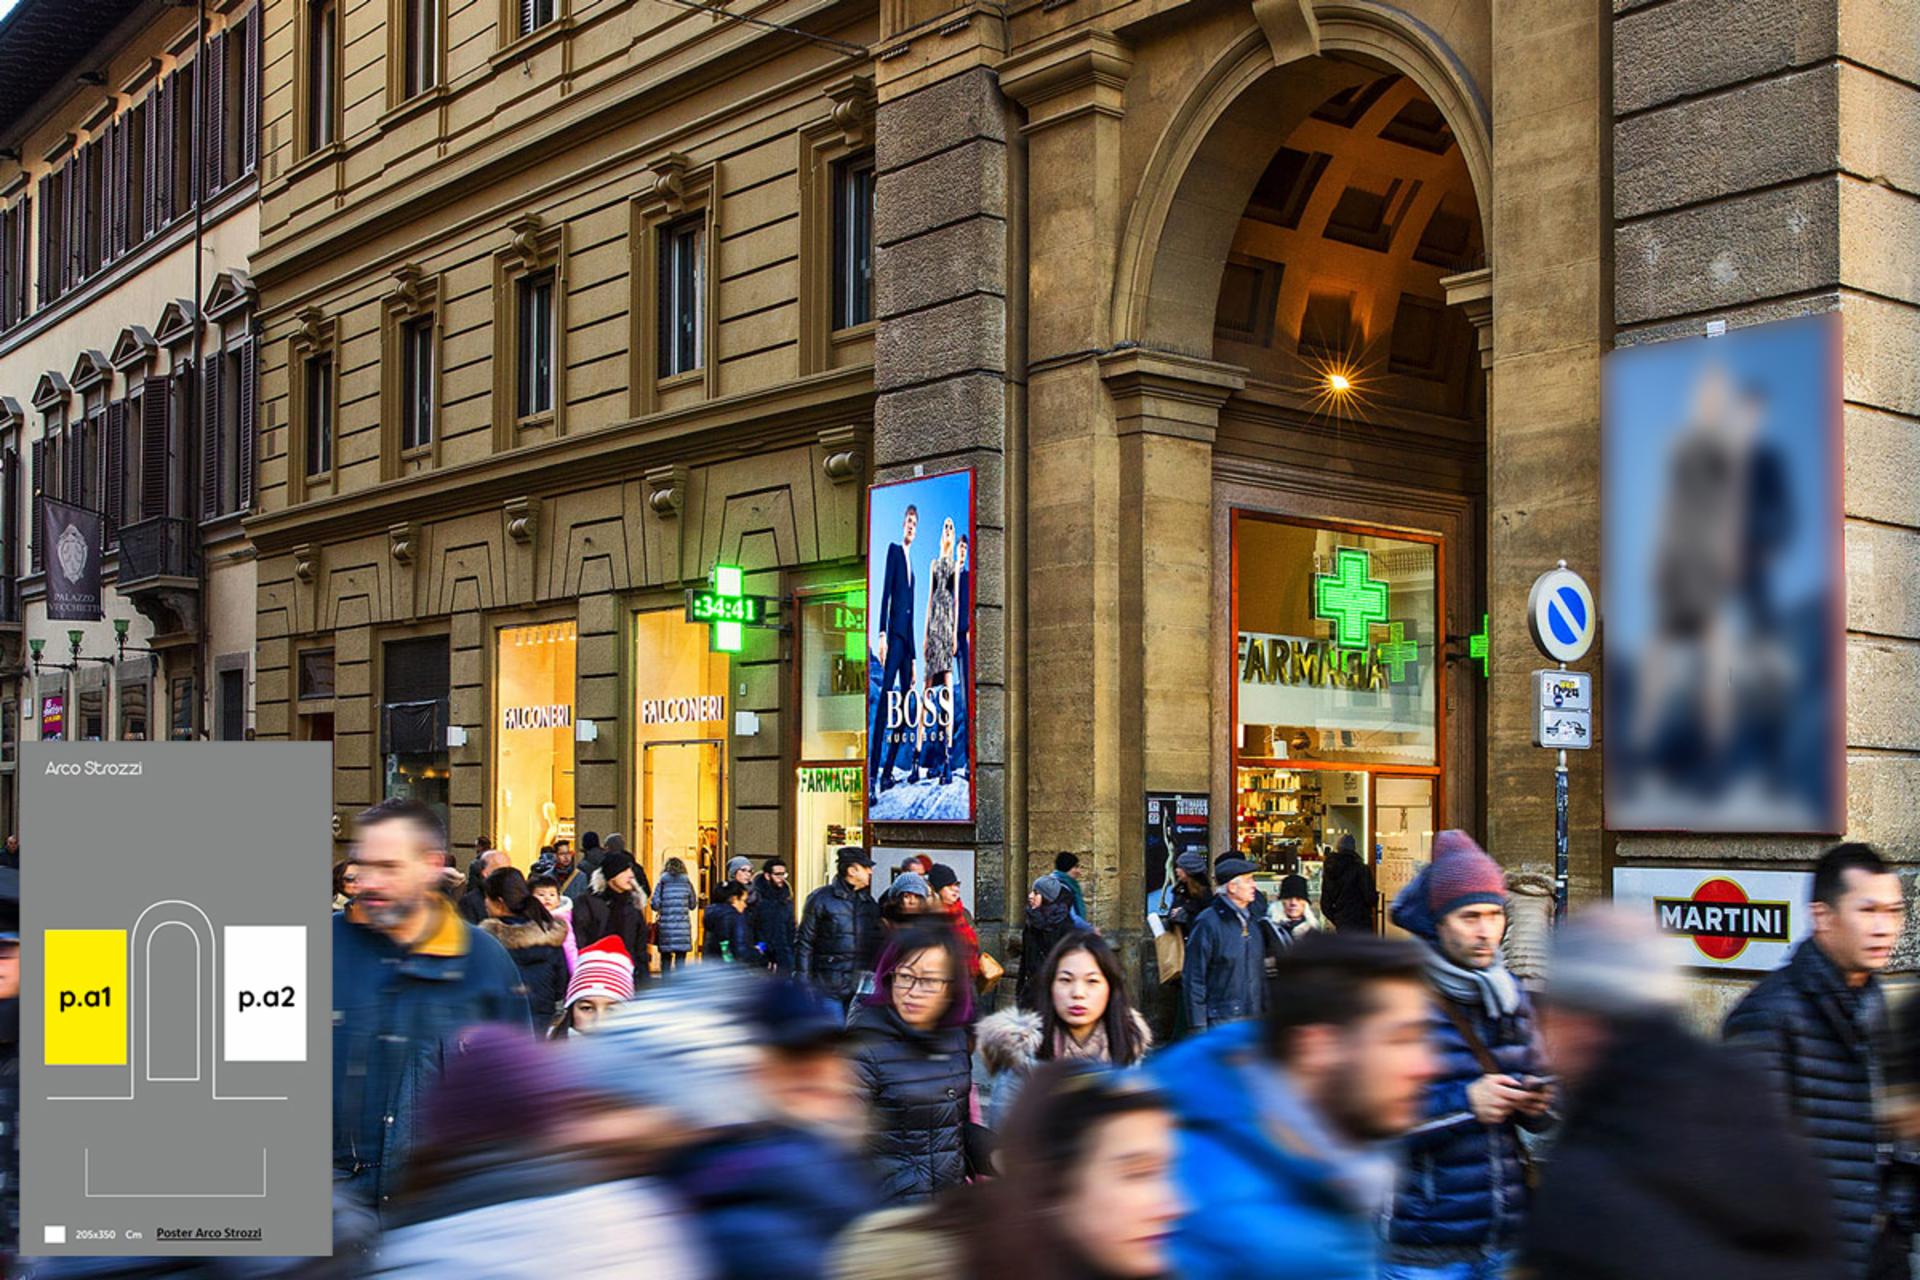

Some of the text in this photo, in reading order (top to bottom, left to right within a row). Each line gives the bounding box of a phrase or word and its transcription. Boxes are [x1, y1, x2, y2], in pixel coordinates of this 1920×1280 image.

[54, 593, 95, 602] PALAZZO
[504, 704, 571, 730] FALCONERI
[642, 695, 724, 724] FALCONERI
[886, 686, 953, 728] BOSS
[921, 730, 950, 742] BOS
[801, 768, 862, 793] FARMACIA
[1660, 904, 1782, 934] MARTINI
